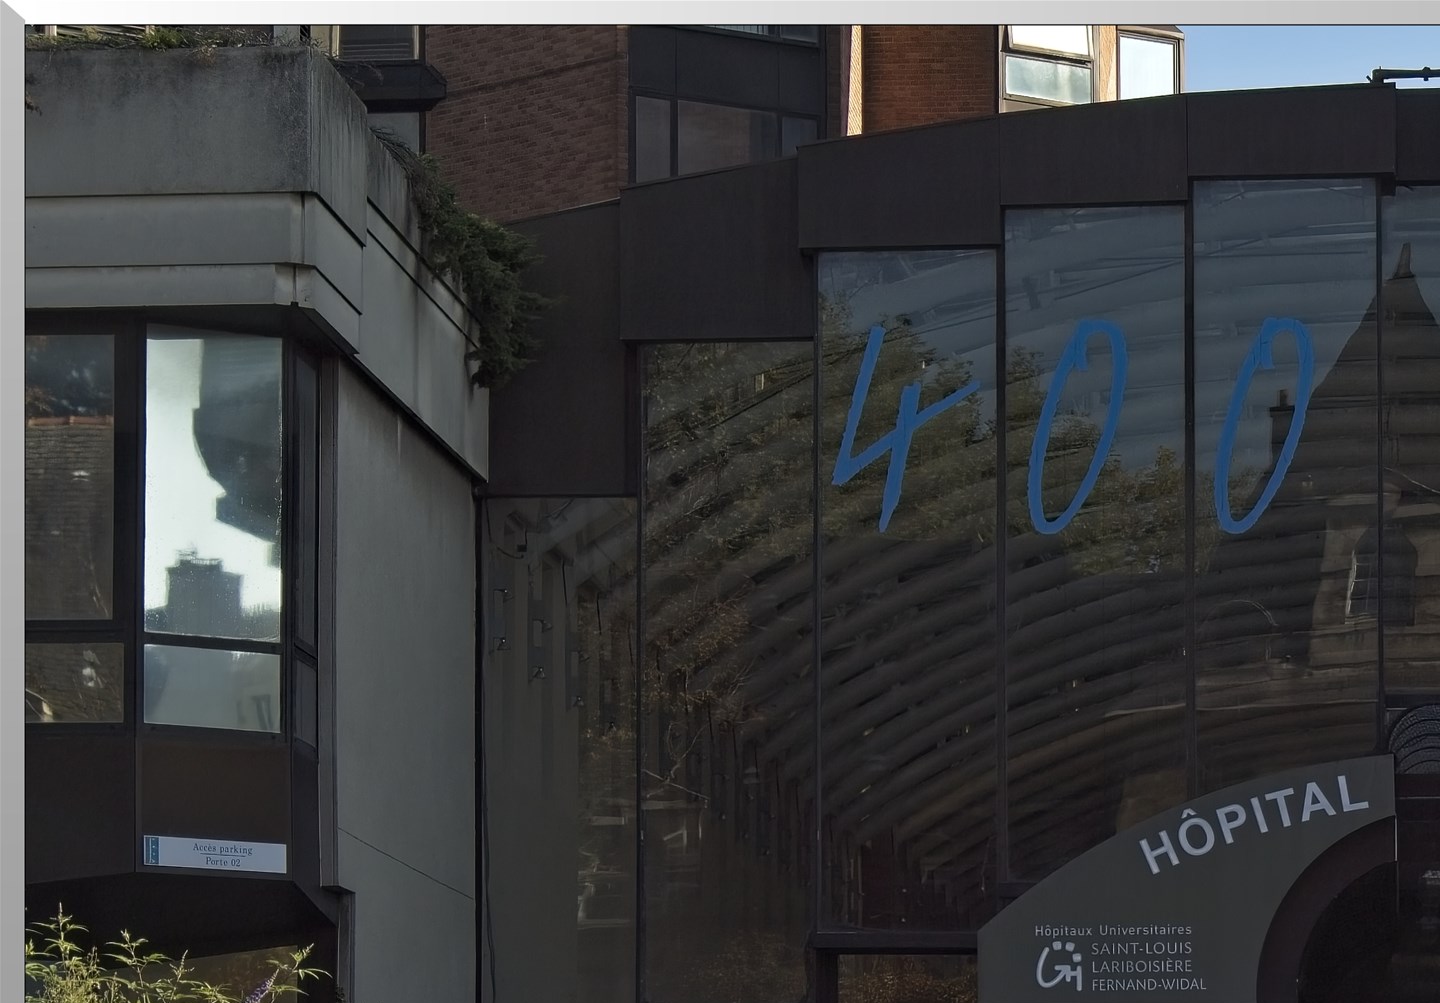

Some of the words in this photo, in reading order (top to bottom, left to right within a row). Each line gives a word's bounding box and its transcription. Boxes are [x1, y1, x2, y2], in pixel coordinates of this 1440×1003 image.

[832, 317, 1314, 535] 400
[1138, 775, 1370, 875] HÔPITAL
[193, 842, 217, 853] Accès
[219, 844, 253, 856] parking
[205, 856, 228, 867] Porte
[230, 858, 241, 867] 02
[1035, 924, 1093, 939] Hôpitaux
[1099, 923, 1193, 936] Universitaires
[1090, 941, 1193, 956] SAINT-LOUIS
[1092, 957, 1193, 974] LARIBOISIÈRE
[1092, 977, 1207, 992] FERNAND-WIDAL
